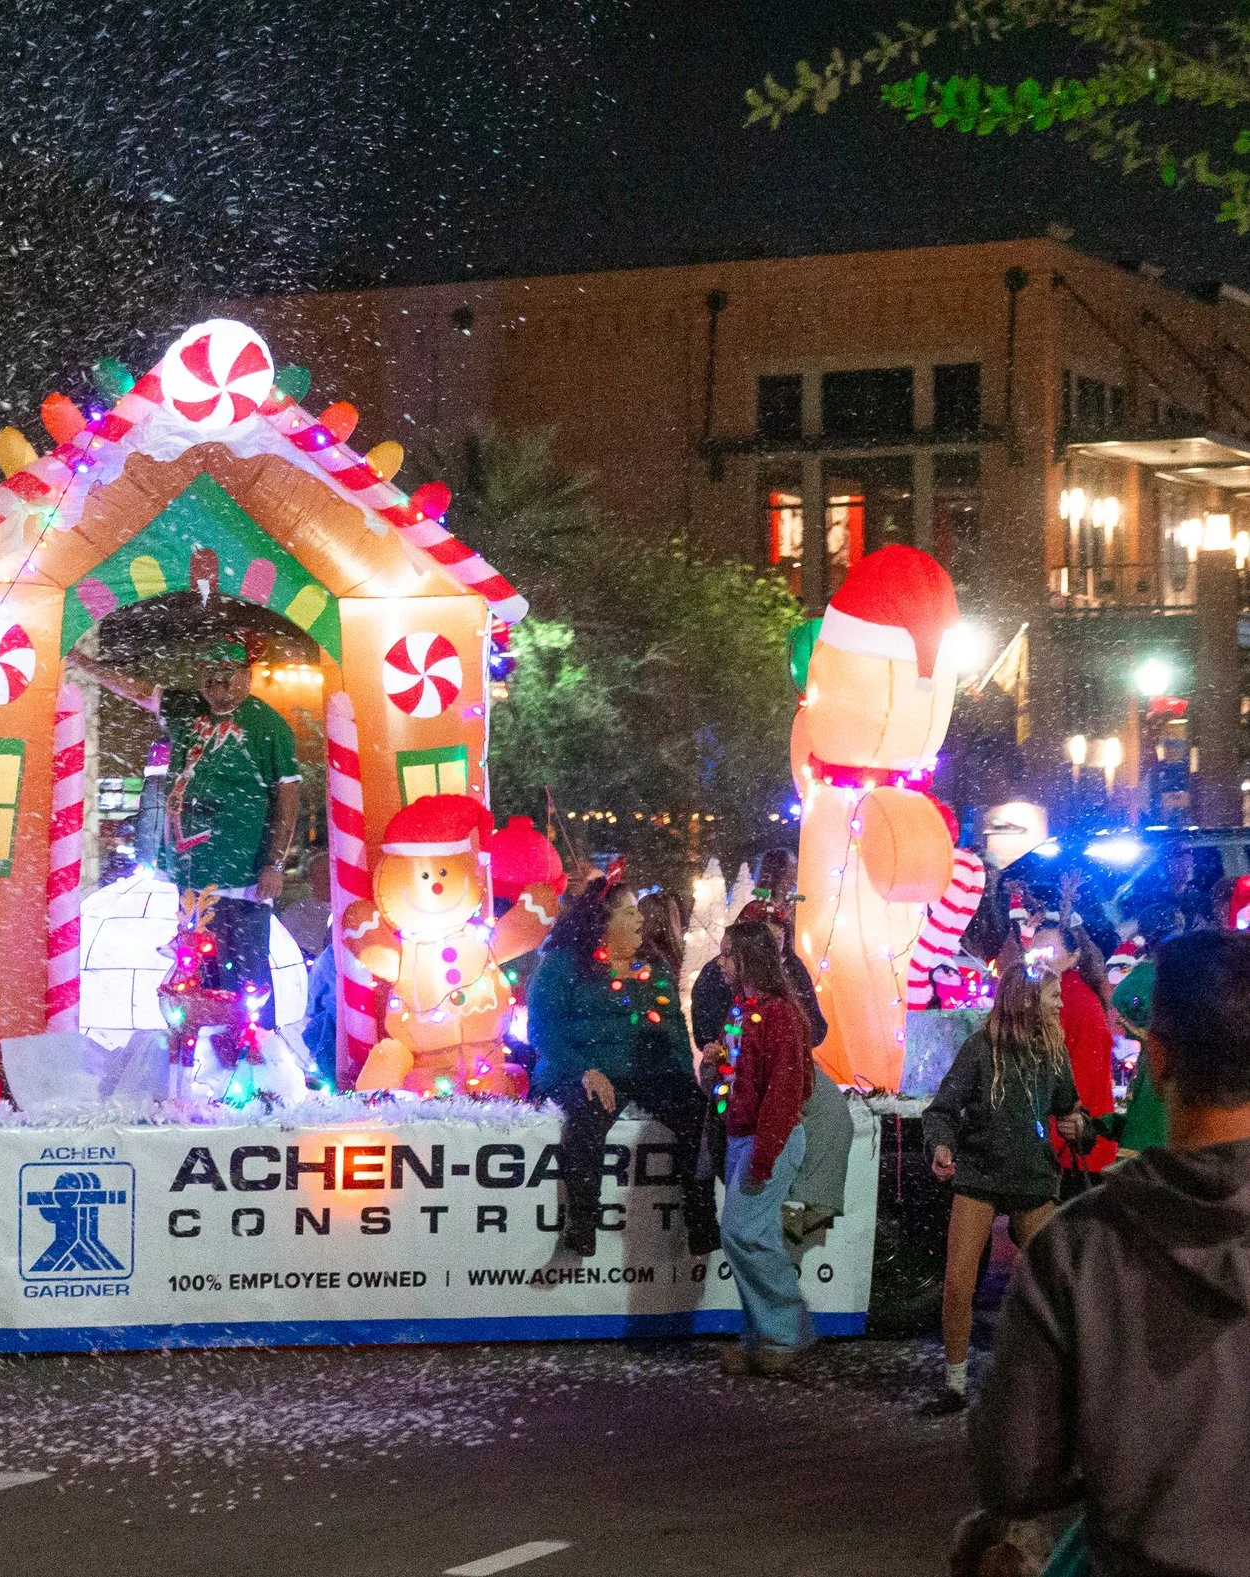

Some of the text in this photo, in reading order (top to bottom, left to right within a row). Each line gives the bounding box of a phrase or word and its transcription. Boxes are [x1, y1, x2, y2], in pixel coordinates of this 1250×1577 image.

[39, 1146, 117, 1161] ACHEN
[168, 1143, 688, 1193] ACHEN-GARD
[167, 1203, 680, 1239] CONSTRUCT
[23, 1283, 131, 1299] GARDNER
[168, 1267, 655, 1293] 100% EMPLOYEE OWNED WWW.ACHEN.COM
